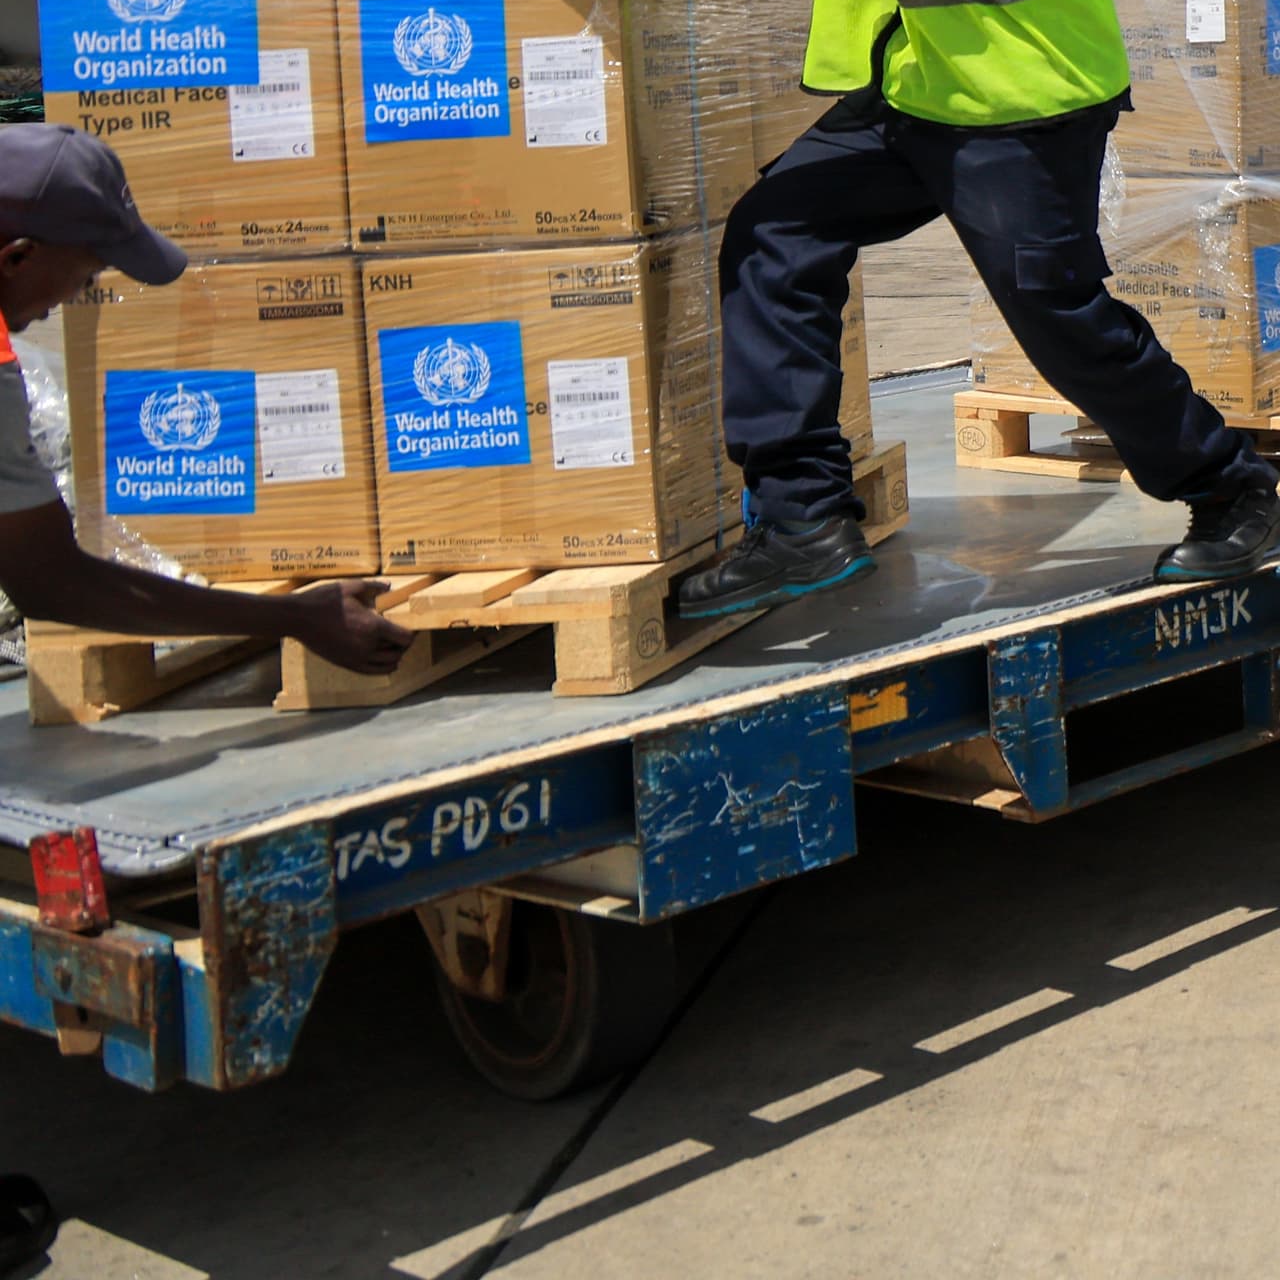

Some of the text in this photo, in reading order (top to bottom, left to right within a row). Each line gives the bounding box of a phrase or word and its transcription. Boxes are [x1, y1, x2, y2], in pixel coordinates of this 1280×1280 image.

[73, 26, 226, 54] World Health
[73, 52, 227, 84] Organization
[78, 86, 227, 108] Medical Face
[373, 78, 430, 102] World
[437, 77, 499, 99] Health
[79, 111, 172, 136] Type IIR
[374, 99, 500, 127] Organization
[1116, 261, 1178, 277] Disposable
[370, 274, 413, 291] KNH
[1116, 279, 1191, 297] Medical Face
[394, 411, 450, 433] World
[457, 405, 518, 428] Health
[396, 429, 520, 458] Organization
[116, 455, 245, 475] World Health
[115, 477, 245, 501] Organization
[1153, 587, 1253, 653] NMJK
[334, 817, 412, 880] TAS
